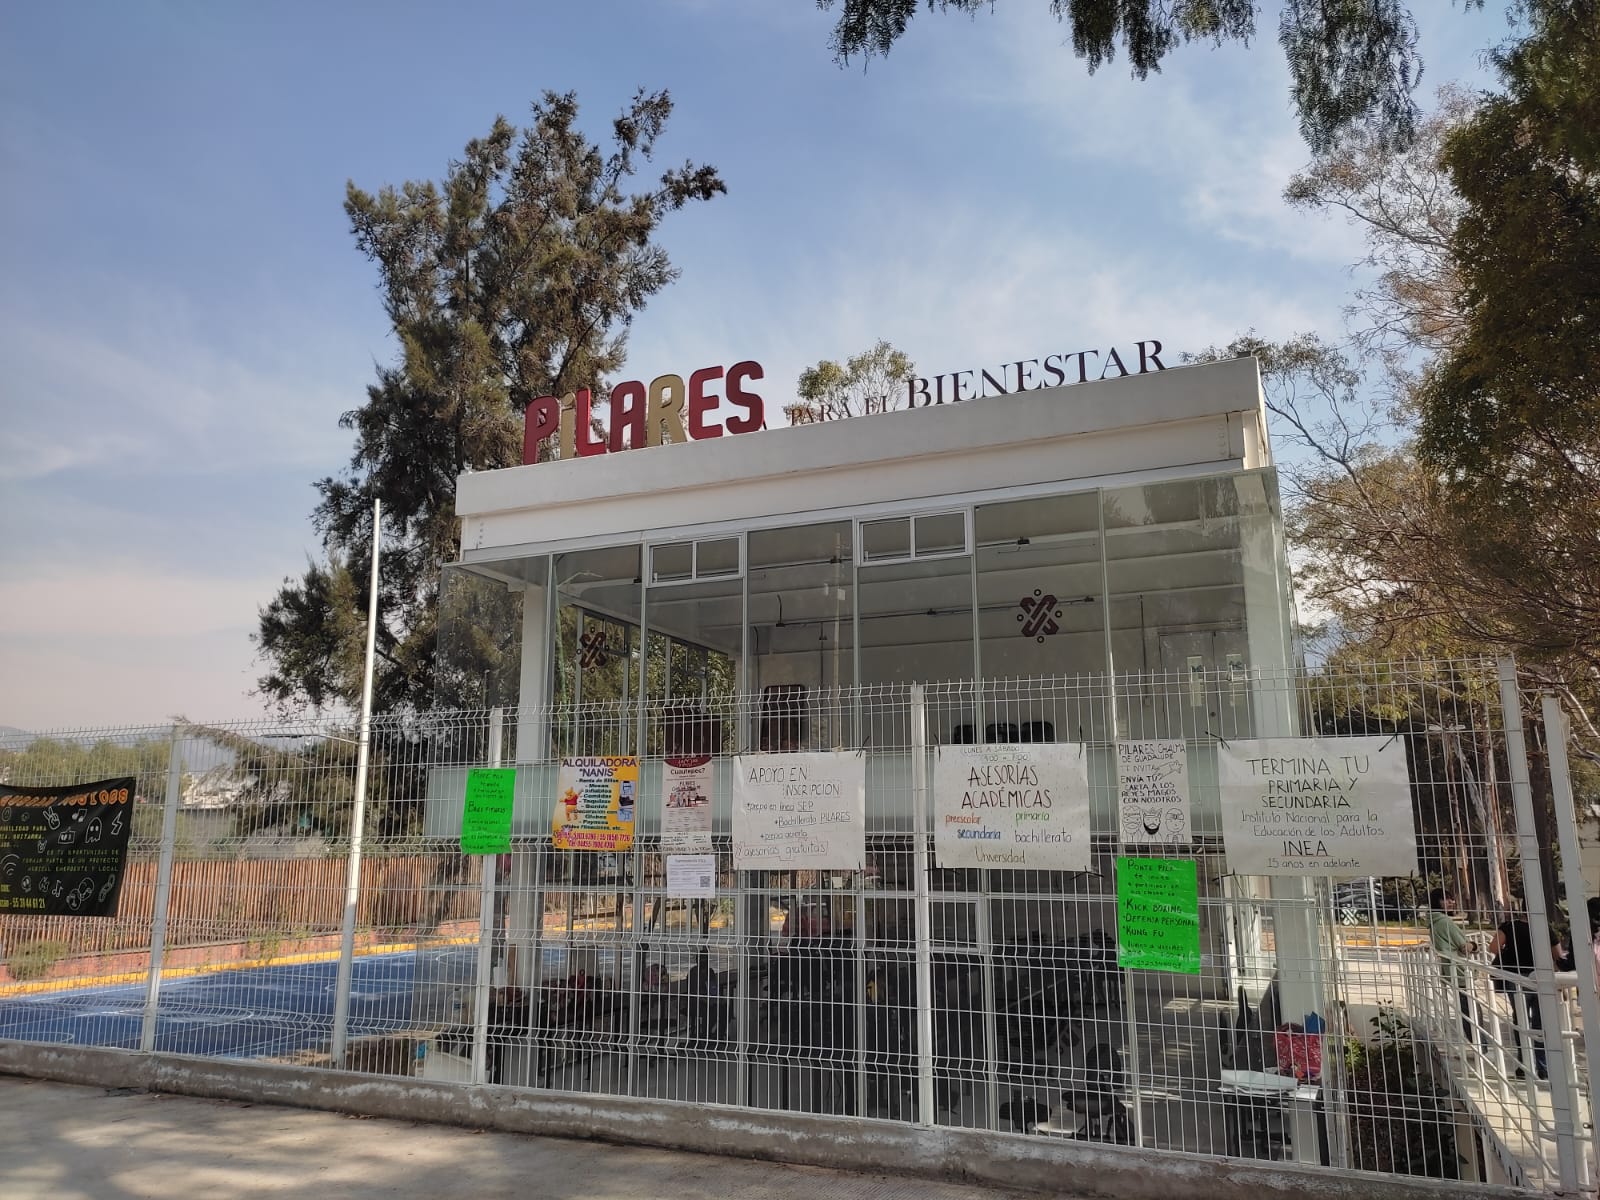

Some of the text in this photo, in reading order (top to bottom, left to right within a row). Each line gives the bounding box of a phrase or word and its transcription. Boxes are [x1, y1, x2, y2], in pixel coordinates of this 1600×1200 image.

[791, 401, 852, 426] PARA
[906, 340, 1167, 409] BIENESTAR
[1118, 744, 1185, 755] PILARES CHALMA
[563, 758, 637, 768] ALQUILADORA
[1135, 754, 1173, 762] GUADALUPE
[1246, 755, 1369, 776] TERMINA TU
[580, 768, 618, 777] "NANIS"
[749, 767, 808, 783] APOYO EN
[968, 762, 1039, 787] ASESORÍAS
[1269, 778, 1358, 794] PRIMARIA Y
[961, 787, 1052, 809] ACADÉMICAS
[1262, 796, 1351, 809] SECUNDARIA
[797, 801, 814, 812] SEP
[779, 811, 851, 826] Bachillerato PILARES
[945, 811, 1050, 826] preescolar primaria
[1242, 809, 1378, 827] Instituto Nacional para la
[958, 825, 1072, 843] secundaria bachillerato
[1254, 823, 1384, 837] Educación de los Adultos
[786, 842, 826, 859] gratuitas
[975, 846, 1026, 864] Universidad
[1283, 840, 1329, 856] INEA
[1267, 859, 1279, 868] 15
[1324, 859, 1360, 868] adelante
[1162, 916, 1195, 926] PERSONAL
[1126, 927, 1147, 936] KUNG
